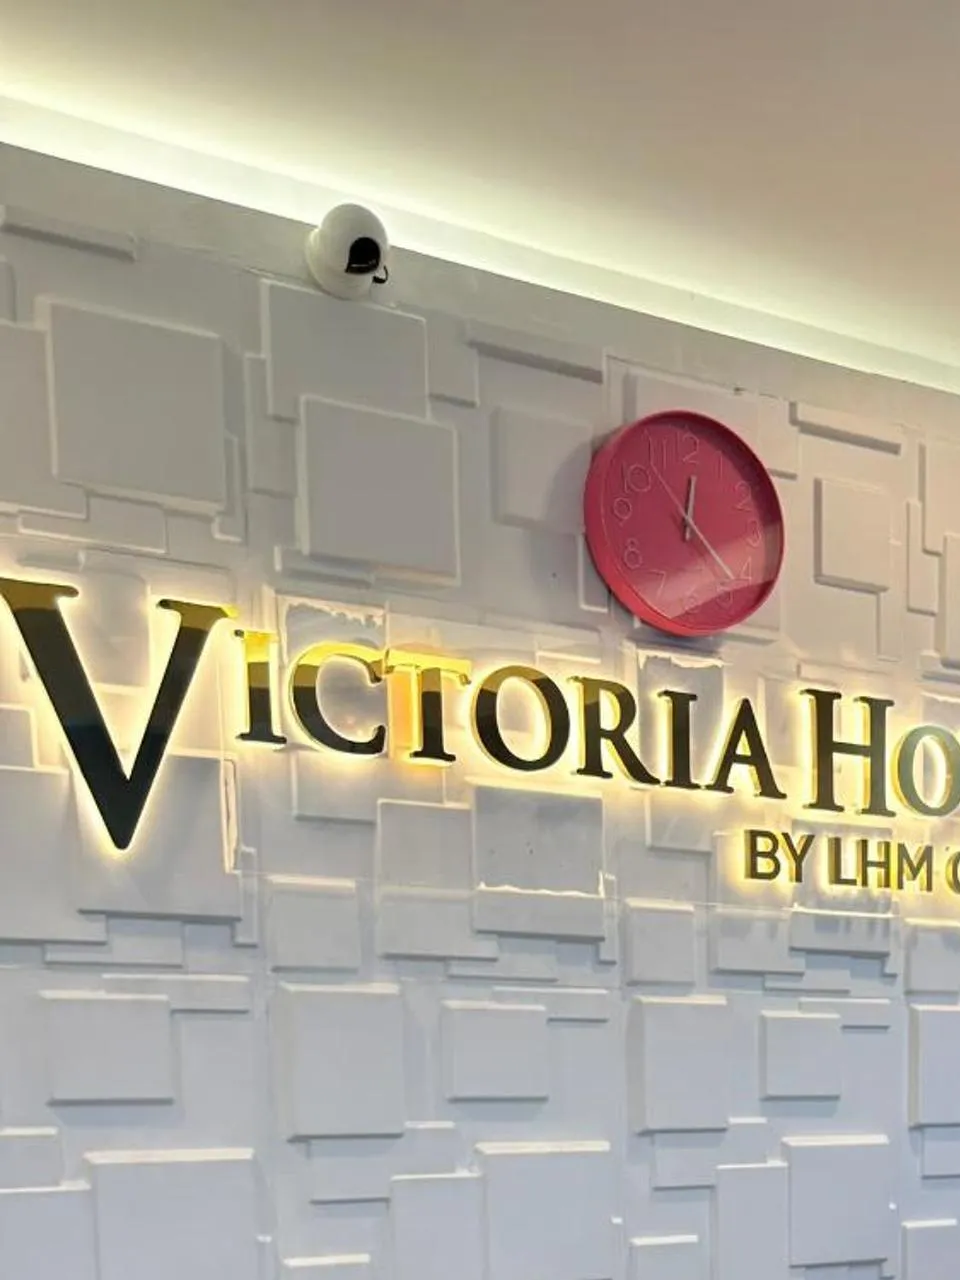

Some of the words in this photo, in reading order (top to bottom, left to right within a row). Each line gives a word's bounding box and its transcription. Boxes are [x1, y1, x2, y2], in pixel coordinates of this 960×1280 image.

[613, 497, 632, 527] 9
[624, 538, 643, 570] 8
[0, 578, 787, 851] VICTORIA
[744, 829, 815, 884] BY
[827, 836, 933, 892] LHM
